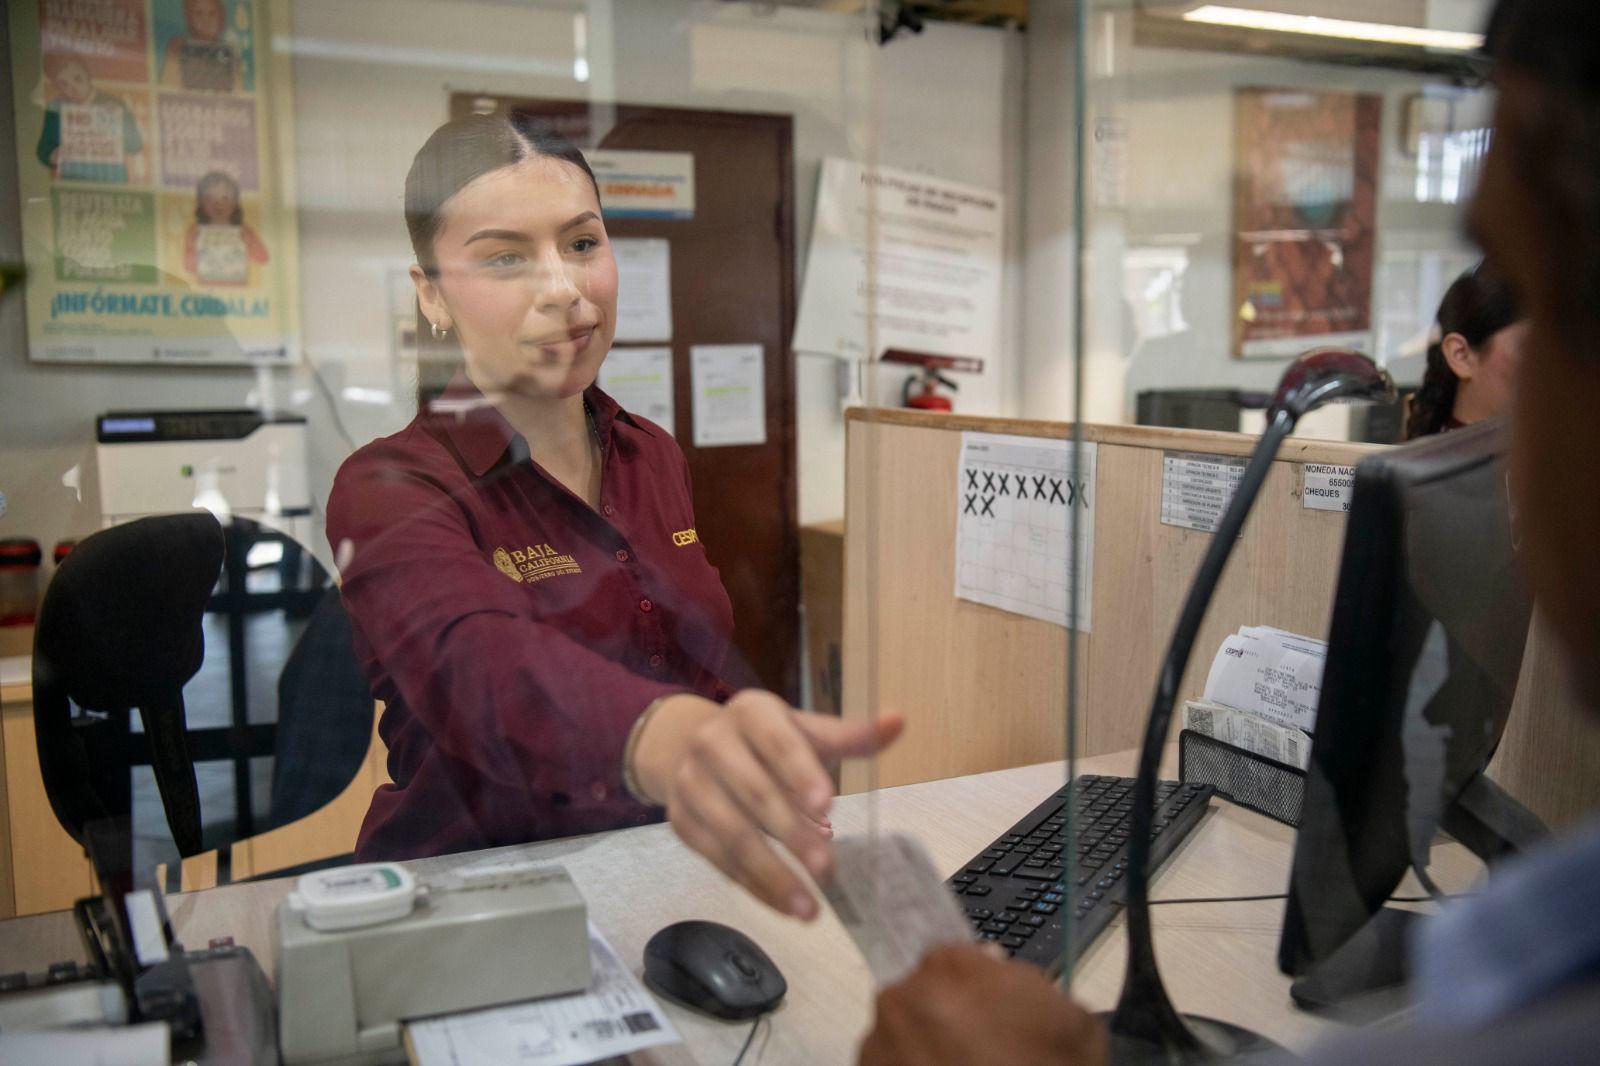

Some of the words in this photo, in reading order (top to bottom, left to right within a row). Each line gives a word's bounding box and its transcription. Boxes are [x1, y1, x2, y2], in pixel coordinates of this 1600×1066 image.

[1305, 465, 1337, 475] MONEDA
[1338, 467, 1358, 476] NAC
[1304, 487, 1340, 498] CHEQUES
[510, 543, 558, 564] BAJA
[520, 554, 576, 573] CALIFORNIA
